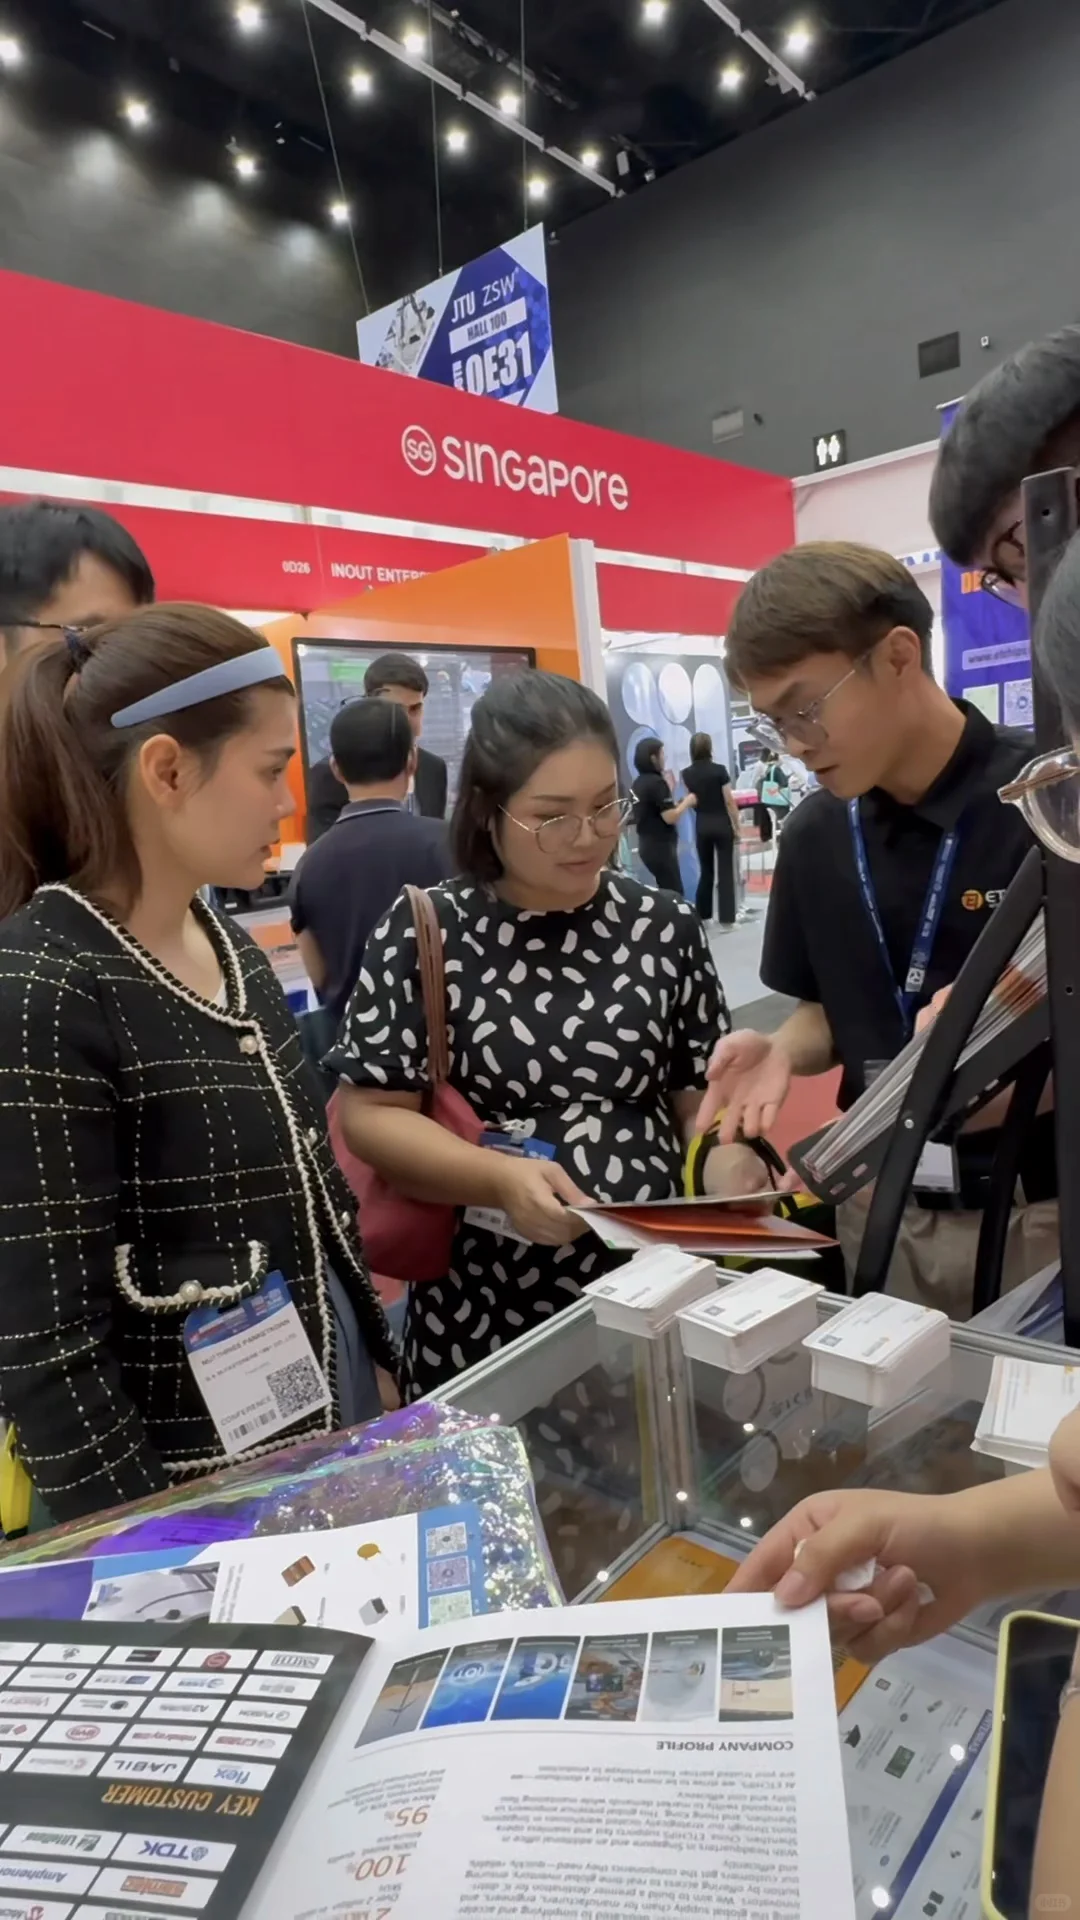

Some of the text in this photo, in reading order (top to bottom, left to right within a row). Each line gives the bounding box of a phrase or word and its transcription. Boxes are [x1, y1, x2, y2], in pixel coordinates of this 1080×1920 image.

[452, 271, 515, 323] JTU ZSW
[467, 310, 508, 341] HALL 100
[405, 438, 433, 462] SG
[331, 562, 373, 581] INOUT
[221, 1395, 272, 1426] CONFERENCE
[656, 1740, 794, 1751] COMPANY PROFILE
[114, 1760, 178, 1773] JABIL
[214, 1768, 251, 1785] flex
[101, 1784, 260, 1816] KEY CUSTOMER
[137, 1841, 189, 1860] TDK
